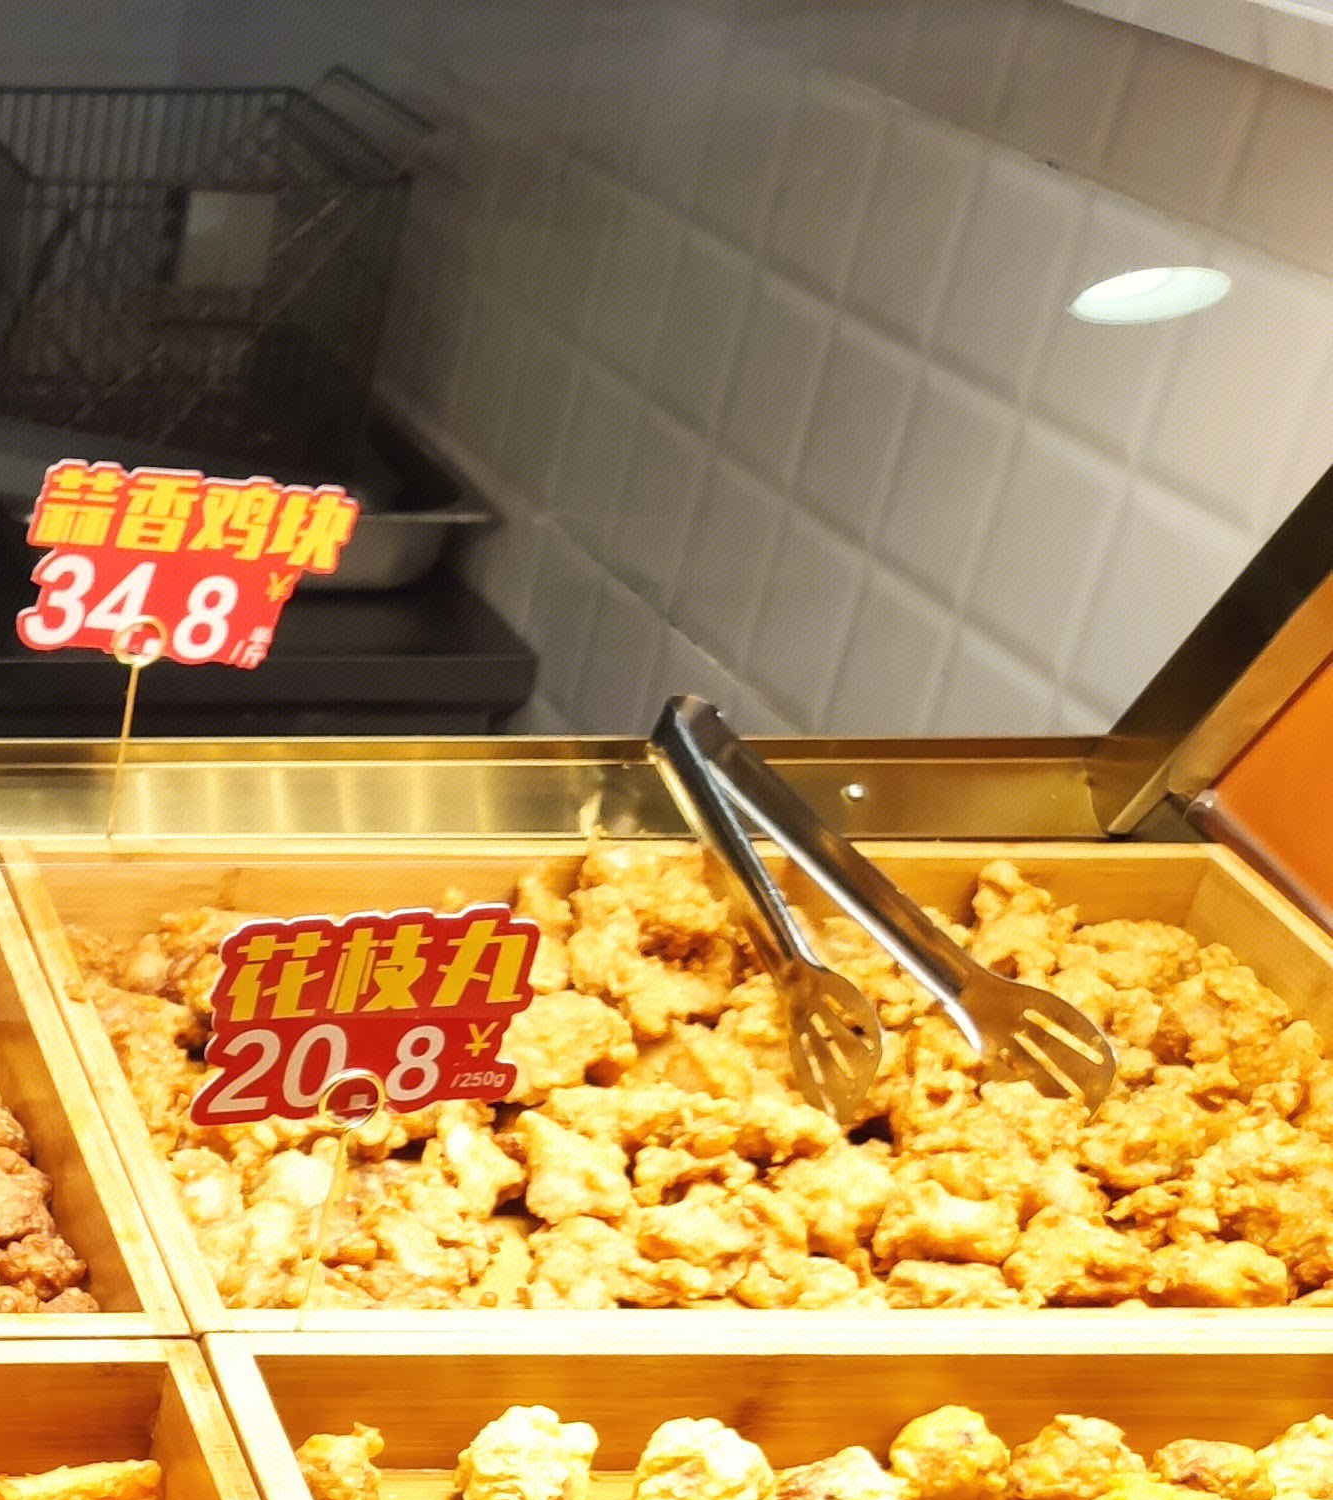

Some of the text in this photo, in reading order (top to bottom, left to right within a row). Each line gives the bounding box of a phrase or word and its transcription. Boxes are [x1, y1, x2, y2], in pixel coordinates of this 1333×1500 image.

[35, 467, 353, 570] 蒜香鸡块
[23, 553, 240, 660] 34.8
[227, 919, 529, 1022] 花枝丸
[207, 1023, 445, 1114] 20.8
[450, 1070, 507, 1089] /250g
